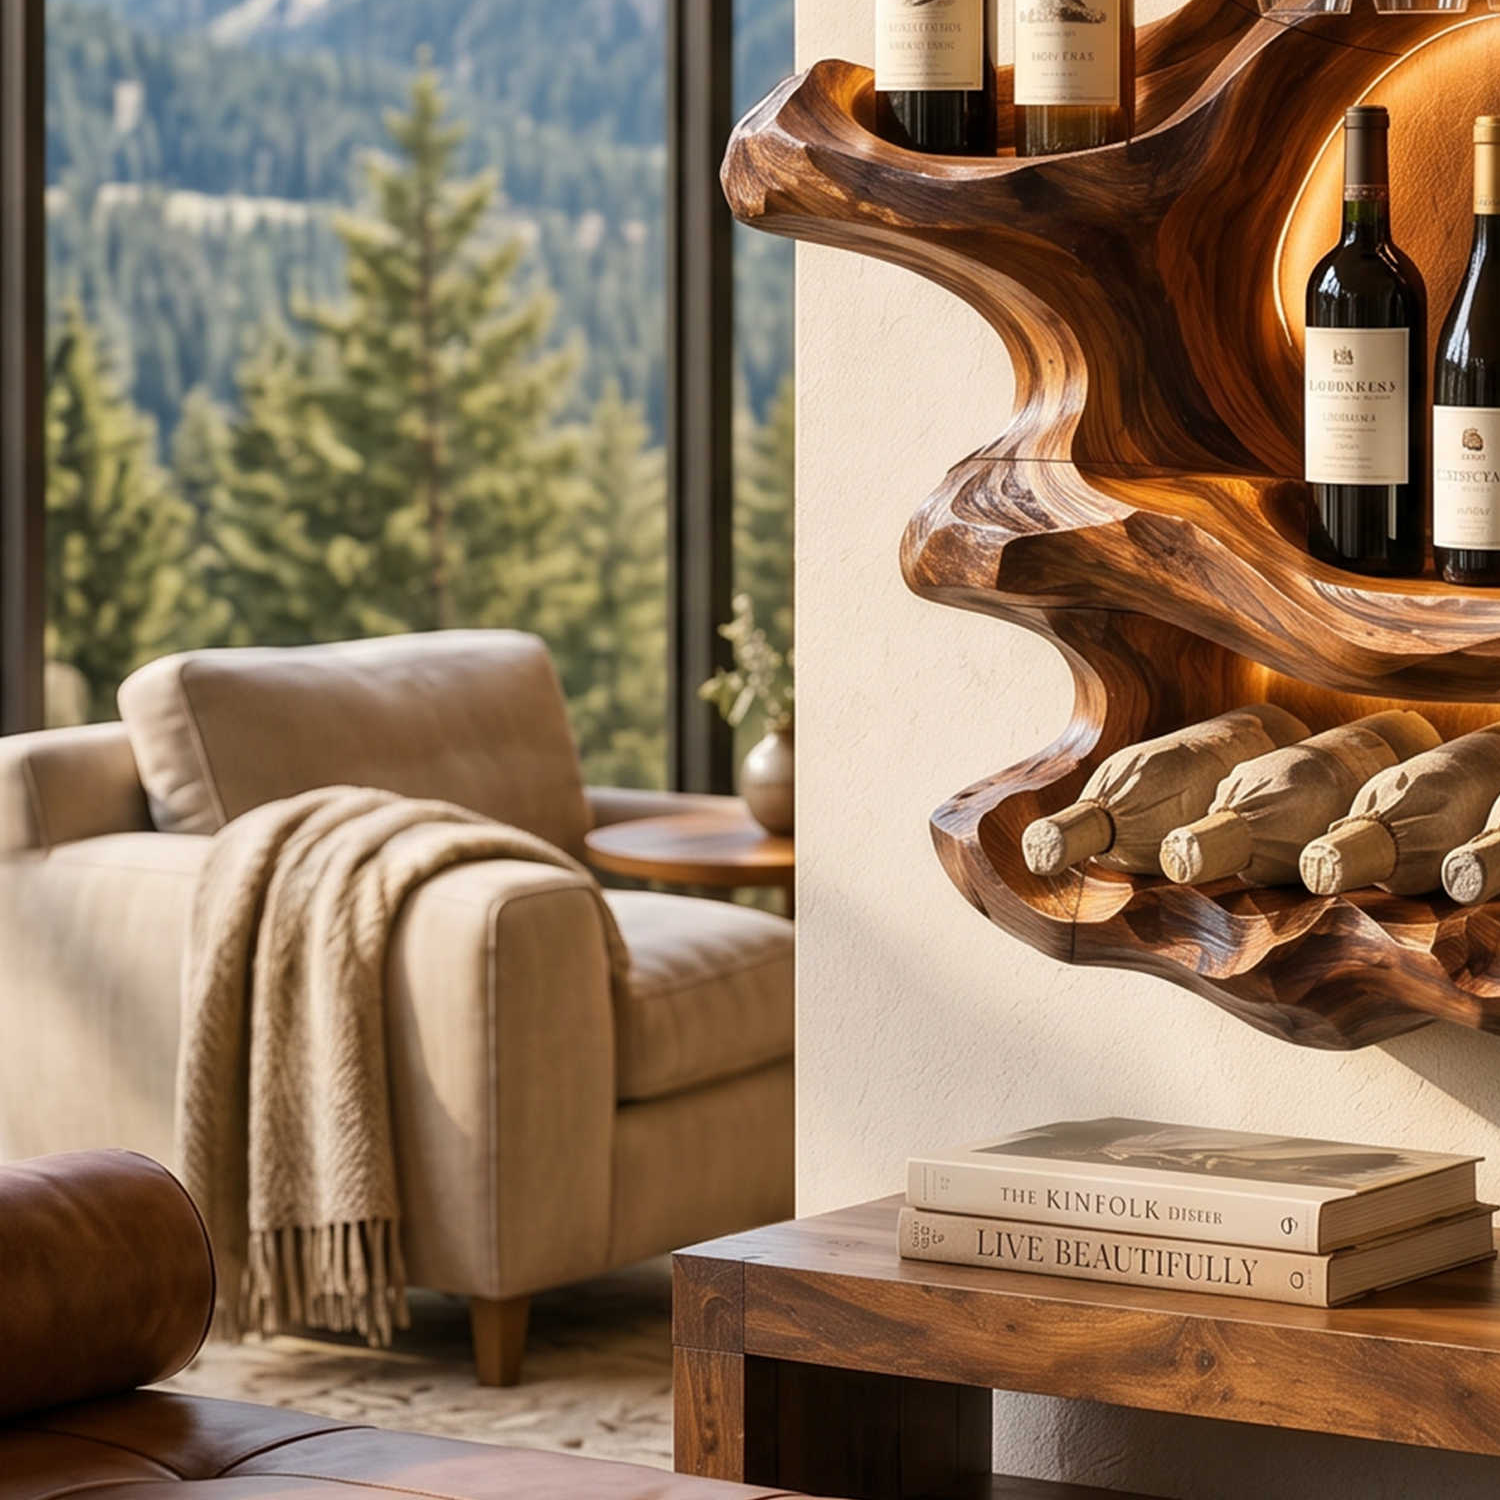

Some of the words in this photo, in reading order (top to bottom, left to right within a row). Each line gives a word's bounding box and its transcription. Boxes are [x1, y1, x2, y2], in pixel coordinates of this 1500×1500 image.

[1001, 1186, 1037, 1205] THE
[1046, 1188, 1160, 1220] KINFOLK
[976, 1228, 1044, 1263] LIVE
[1055, 1237, 1259, 1286] BEAUTIFULLY
